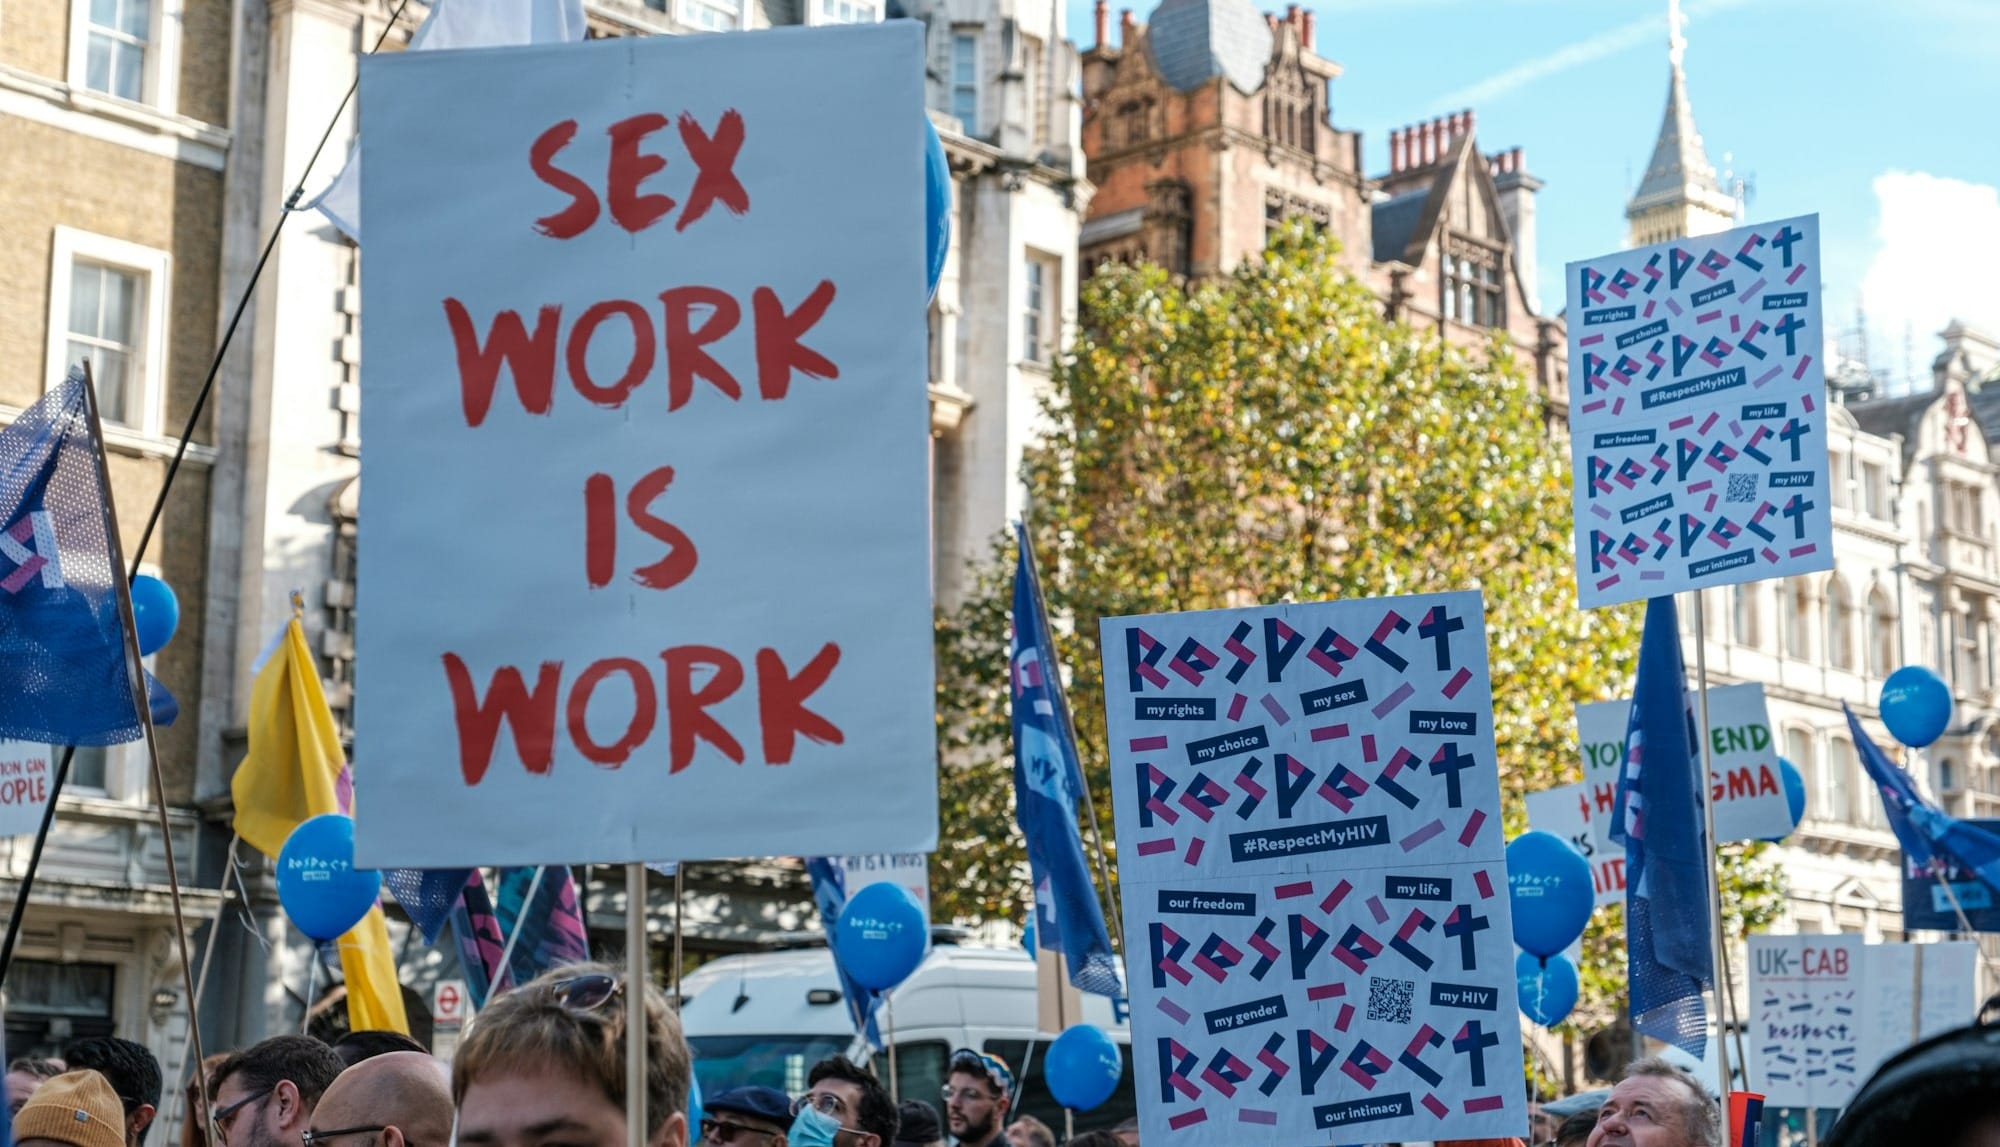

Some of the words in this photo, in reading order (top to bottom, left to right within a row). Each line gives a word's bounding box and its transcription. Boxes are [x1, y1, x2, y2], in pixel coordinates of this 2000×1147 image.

[529, 108, 750, 240] SEX
[1698, 292, 1712, 303] my
[1712, 287, 1728, 297] sex
[1767, 299, 1782, 307] my
[1782, 296, 1803, 306] love
[1590, 314, 1604, 322] my
[1604, 310, 1629, 321] rights
[1621, 335, 1635, 345] my
[1635, 325, 1663, 340] choice
[442, 279, 840, 428] WORK
[1649, 371, 1739, 404] #RespectMyHIV
[1748, 409, 1763, 418] my
[1763, 406, 1779, 416] life
[1599, 437, 1615, 446] our
[1614, 433, 1650, 444] freedom
[1774, 477, 1789, 486] my
[1789, 474, 1809, 484] HIV
[1625, 510, 1639, 520] my
[1639, 499, 1668, 516] gender
[584, 465, 698, 591] IS
[1694, 564, 1710, 574] our
[1710, 555, 1748, 570] intimacy
[1312, 695, 1332, 708] my
[1333, 690, 1357, 703] sex
[440, 641, 845, 787] WORK
[1146, 706, 1166, 718] my
[1168, 703, 1205, 718] rights
[1418, 719, 1439, 732] my
[1440, 716, 1468, 730] love
[1196, 746, 1216, 758] my
[1217, 736, 1259, 753] choice
[1711, 723, 1770, 755] END
[1242, 823, 1378, 854] #RespectMyHIV
[1396, 885, 1417, 897] my
[1418, 882, 1441, 896] life
[1168, 899, 1191, 909] our
[1192, 896, 1245, 911] freedom
[1757, 947, 1849, 975] UK-CAB
[1439, 992, 1460, 1005] my
[1461, 990, 1489, 1005] HIV
[1213, 1015, 1233, 1028] my
[1235, 1004, 1278, 1025] gender
[1324, 1111, 1346, 1123] our
[1347, 1102, 1402, 1119] intimacy
